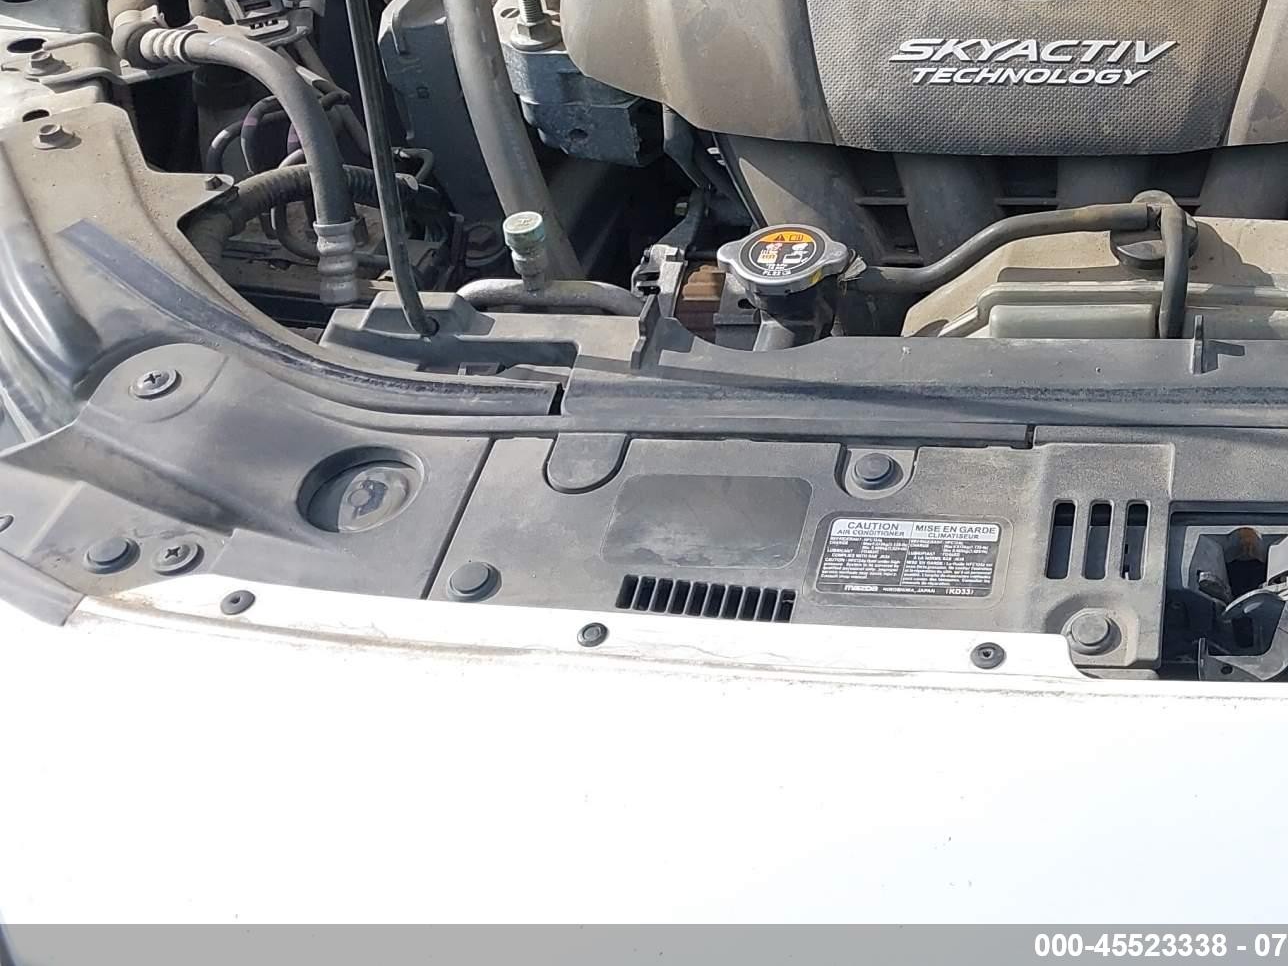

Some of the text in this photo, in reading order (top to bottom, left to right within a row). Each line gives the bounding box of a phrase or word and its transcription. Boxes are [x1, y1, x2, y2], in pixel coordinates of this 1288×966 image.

[889, 38, 1178, 63] SKYACTIV
[911, 67, 1150, 85] TECHNOLOGY
[847, 521, 899, 531] CAUTION
[915, 524, 997, 535] MISE EN GARDE
[852, 529, 905, 537] CONDITIONER
[927, 532, 980, 540] CLIMATISEUR
